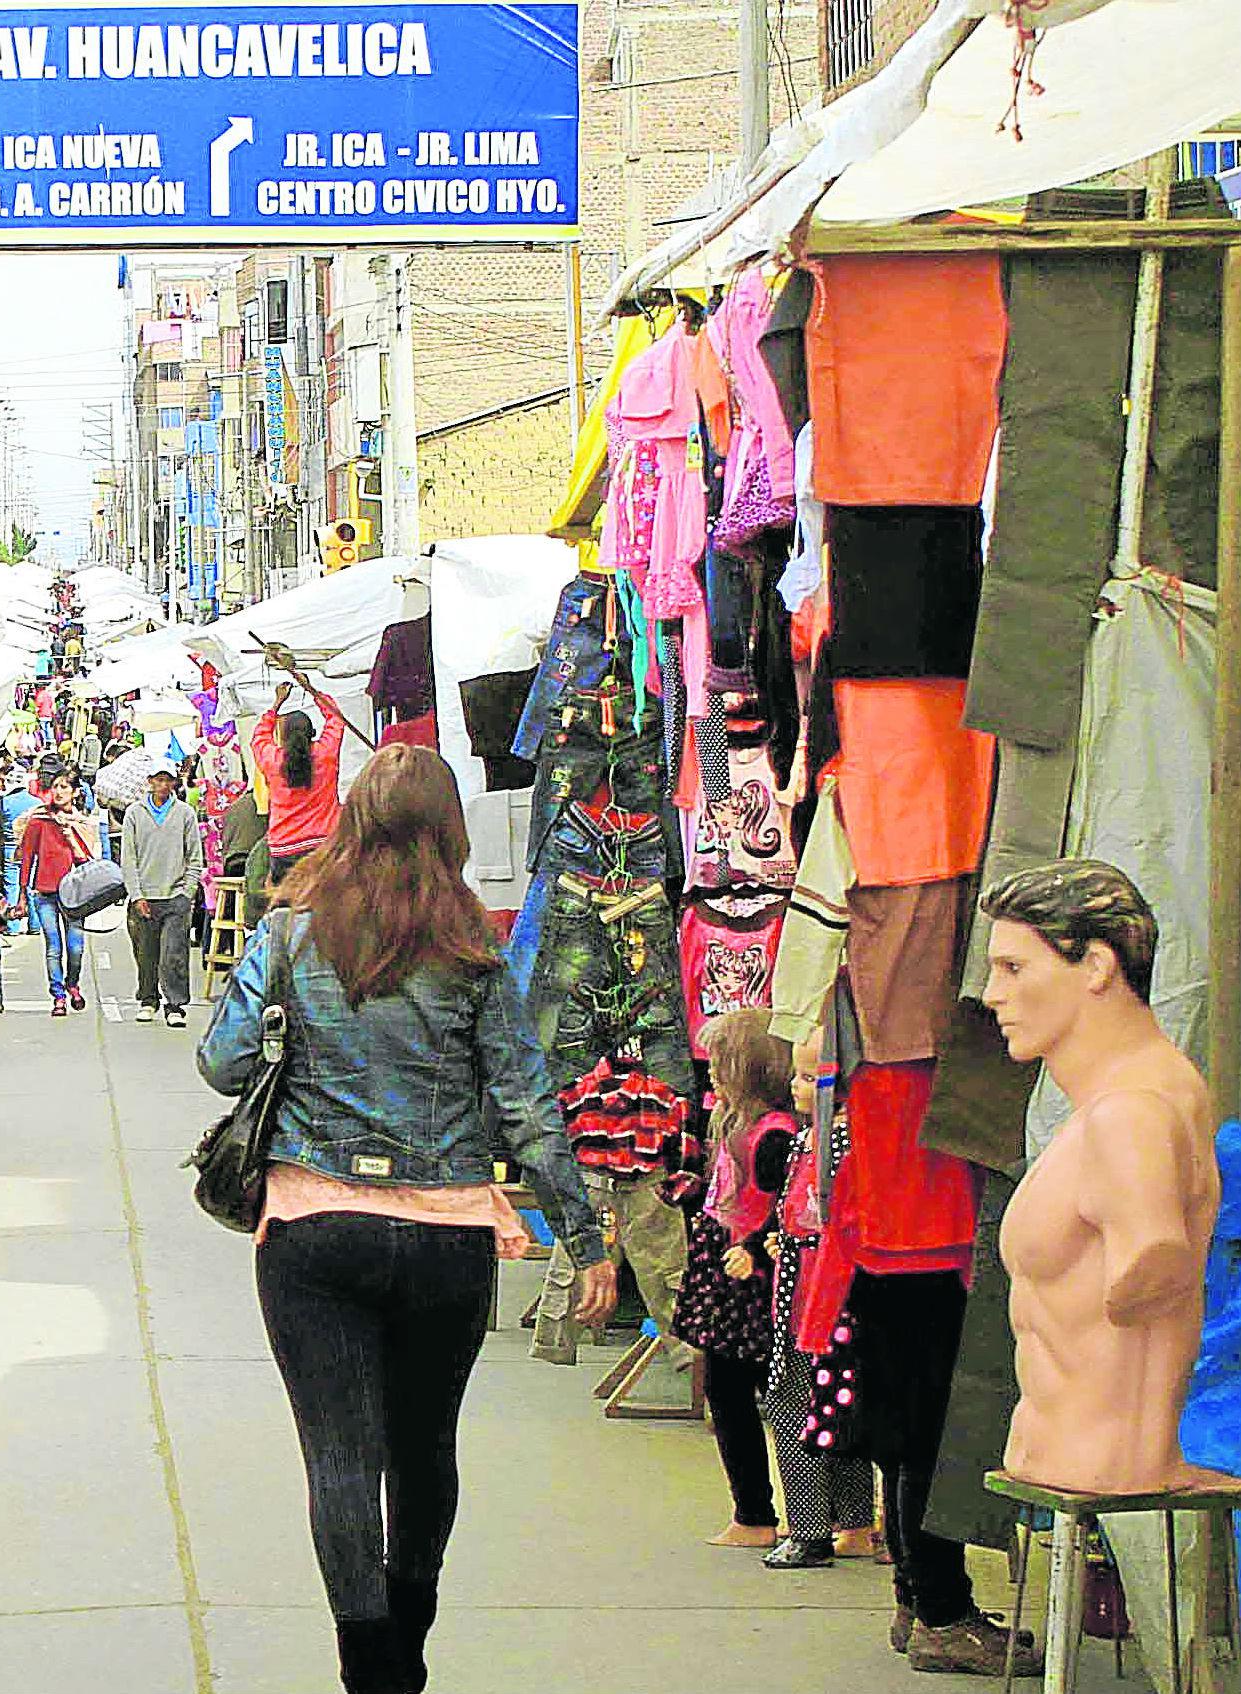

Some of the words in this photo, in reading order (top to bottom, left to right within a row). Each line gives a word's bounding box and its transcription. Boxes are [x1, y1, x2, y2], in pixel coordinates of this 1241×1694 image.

[68, 23, 432, 79] HUANCAVELICA
[3, 135, 58, 170] ICA
[62, 133, 162, 169] NUEVA
[283, 133, 327, 168] JR.
[332, 132, 386, 168] ICA
[397, 147, 411, 156] -
[415, 131, 459, 166] JR.
[464, 131, 539, 166] LIMA
[13, 182, 44, 217] A.
[49, 176, 185, 217] CARRIÓN
[257, 180, 376, 215] CENTRO
[382, 178, 490, 214] CIVICO
[496, 178, 566, 213] HYO.
